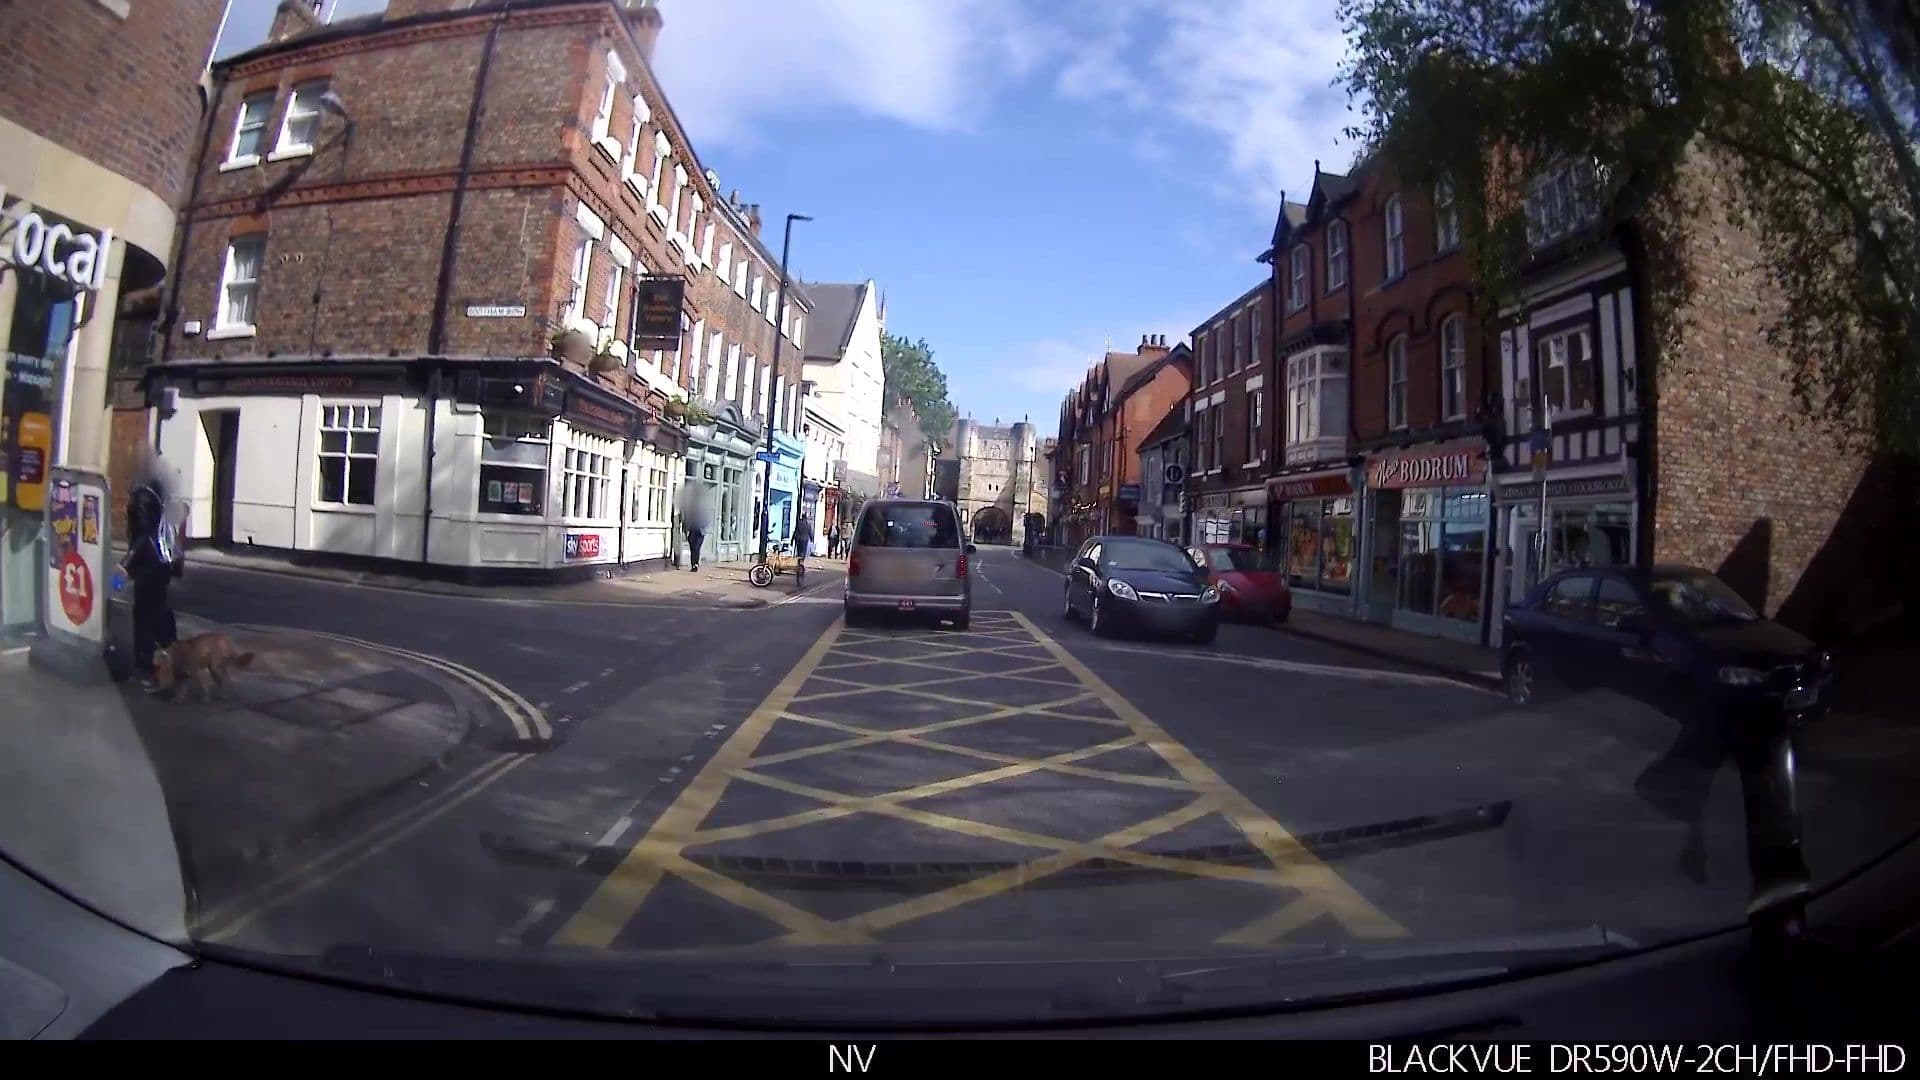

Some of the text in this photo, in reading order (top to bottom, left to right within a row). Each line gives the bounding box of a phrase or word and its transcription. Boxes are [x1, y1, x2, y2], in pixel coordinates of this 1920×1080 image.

[1, 194, 113, 290] ocal
[1400, 452, 1469, 482] BODRUM
[567, 535, 578, 554] sky
[579, 537, 599, 557] sports
[64, 562, 88, 598] £1
